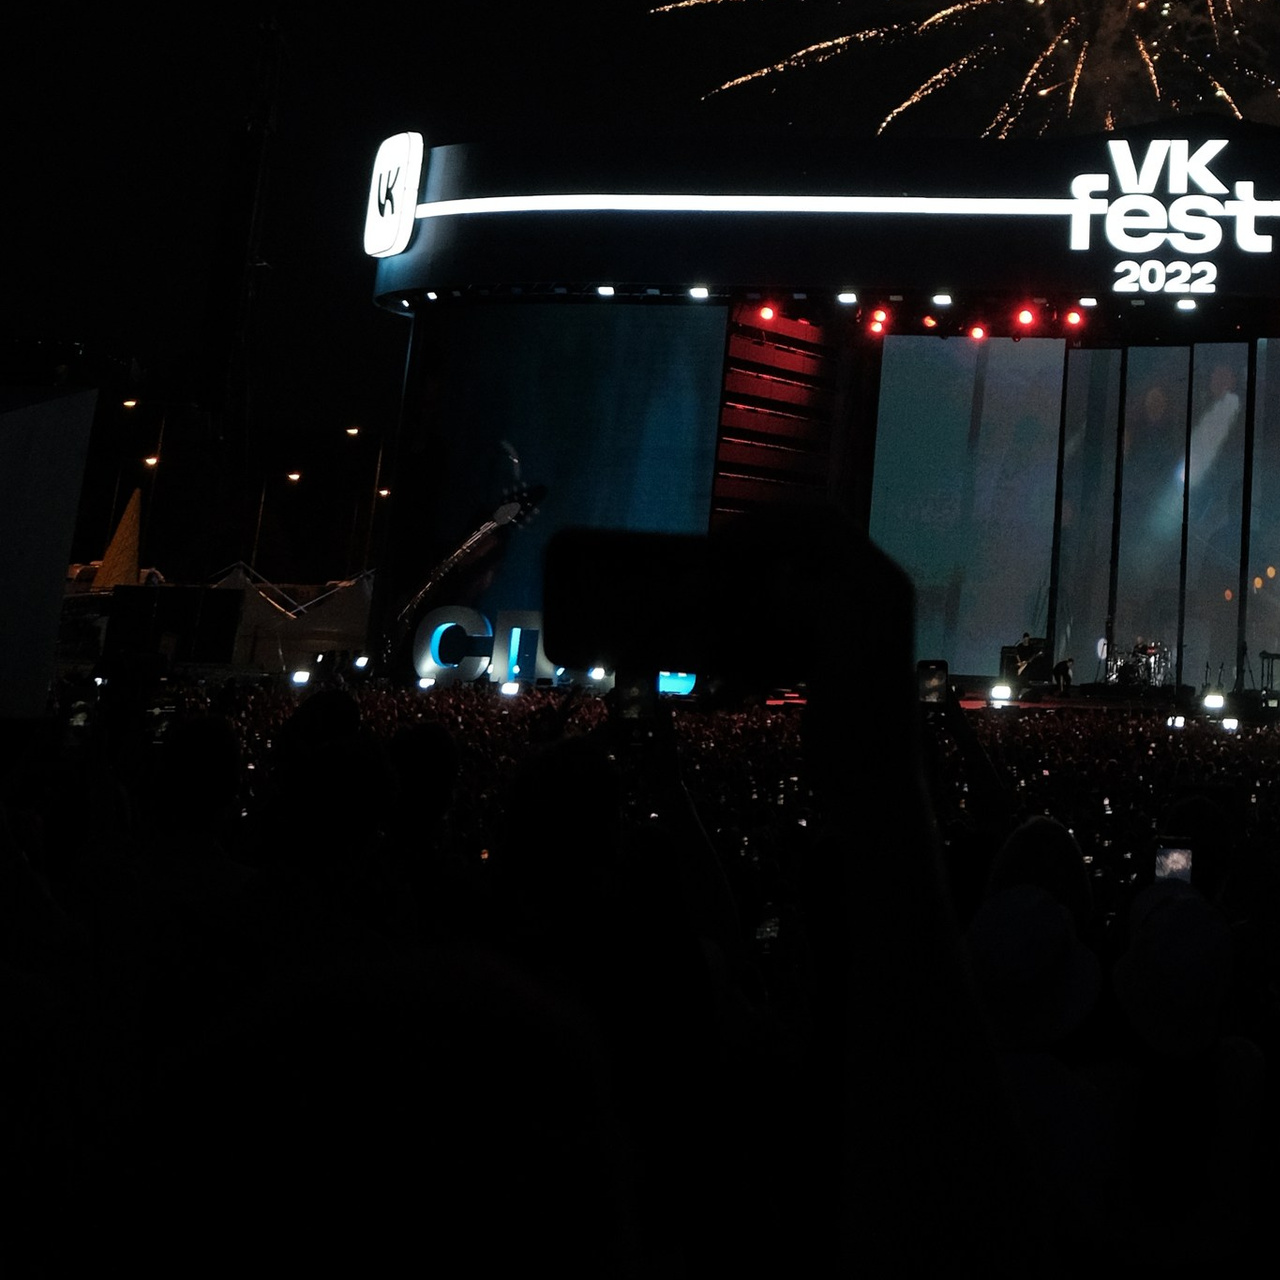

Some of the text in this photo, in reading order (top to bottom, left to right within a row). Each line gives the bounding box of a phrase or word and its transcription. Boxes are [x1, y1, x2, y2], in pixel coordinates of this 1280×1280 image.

[1107, 139, 1230, 195] VK
[1069, 173, 1273, 255] fest
[1112, 259, 1218, 294] 2022
